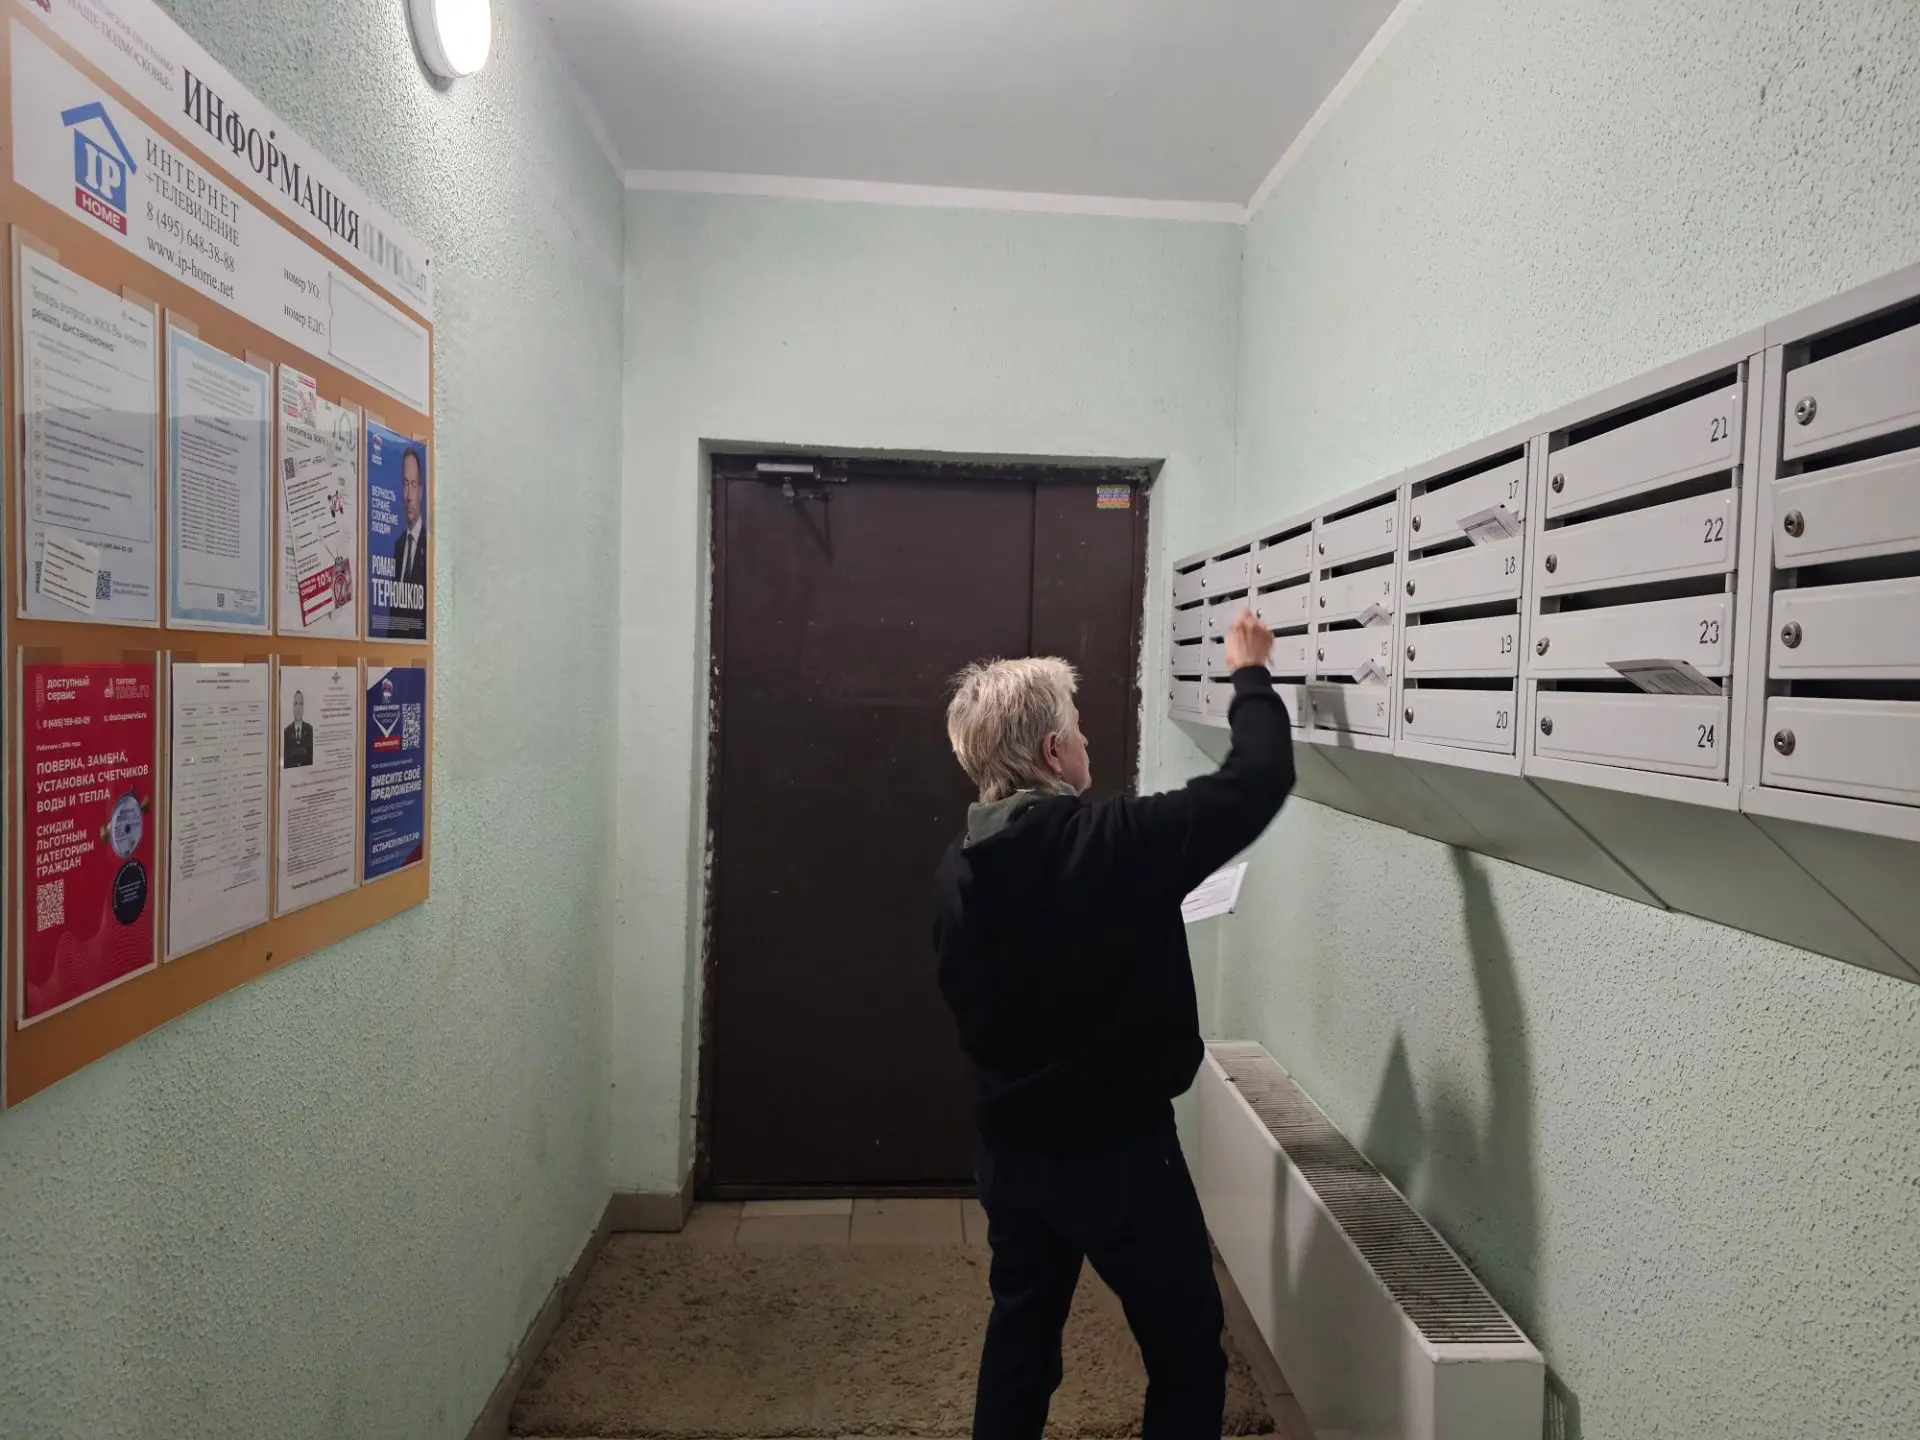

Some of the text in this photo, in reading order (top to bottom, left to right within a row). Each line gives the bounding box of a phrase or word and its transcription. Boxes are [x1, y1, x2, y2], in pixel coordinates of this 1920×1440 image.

[182, 65, 360, 250] ИНФОРМАЦИЯ
[83, 142, 121, 199] IP
[146, 137, 239, 224] ИНТЕРНЕТ
[82, 193, 121, 230] HOME
[146, 172, 240, 248] +ТЕЛЕВИДЕНИЕ
[146, 201, 235, 273] 8 (495) 648-38-88
[147, 236, 235, 299] www.ip-home.net
[284, 268, 306, 293] номер
[284, 305, 306, 328] номер
[1710, 416, 1728, 442] 21
[1509, 479, 1519, 499] 17
[1704, 517, 1724, 543] 22
[371, 555, 396, 578] РОМАН
[1505, 556, 1516, 575] 18
[371, 578, 424, 610] ТЕРЮШКОВ
[1699, 620, 1720, 644] 23
[47, 675, 90, 689] доступный
[47, 690, 76, 702] сервис
[1496, 710, 1508, 729] 20
[1697, 725, 1715, 748] 24
[36, 751, 128, 775] ПОВЕРКА, ЗАМЕНА,
[36, 764, 149, 794] УСТАНОВКА СЧЕТЧИКОВ
[371, 771, 403, 788] ВНЕСИТЕ
[404, 764, 421, 780] СВОЁ
[36, 788, 111, 813] ВОДЫ И ТЕПЛА
[370, 780, 422, 801] ПРЕДЛОЖЕНИЕ
[36, 818, 74, 837] СКИДКИ
[36, 829, 87, 851] ЛЬГОТНЫМ
[36, 840, 94, 866] КАТЕГОРИЯМ
[36, 855, 81, 879] ГРАЖДАН
